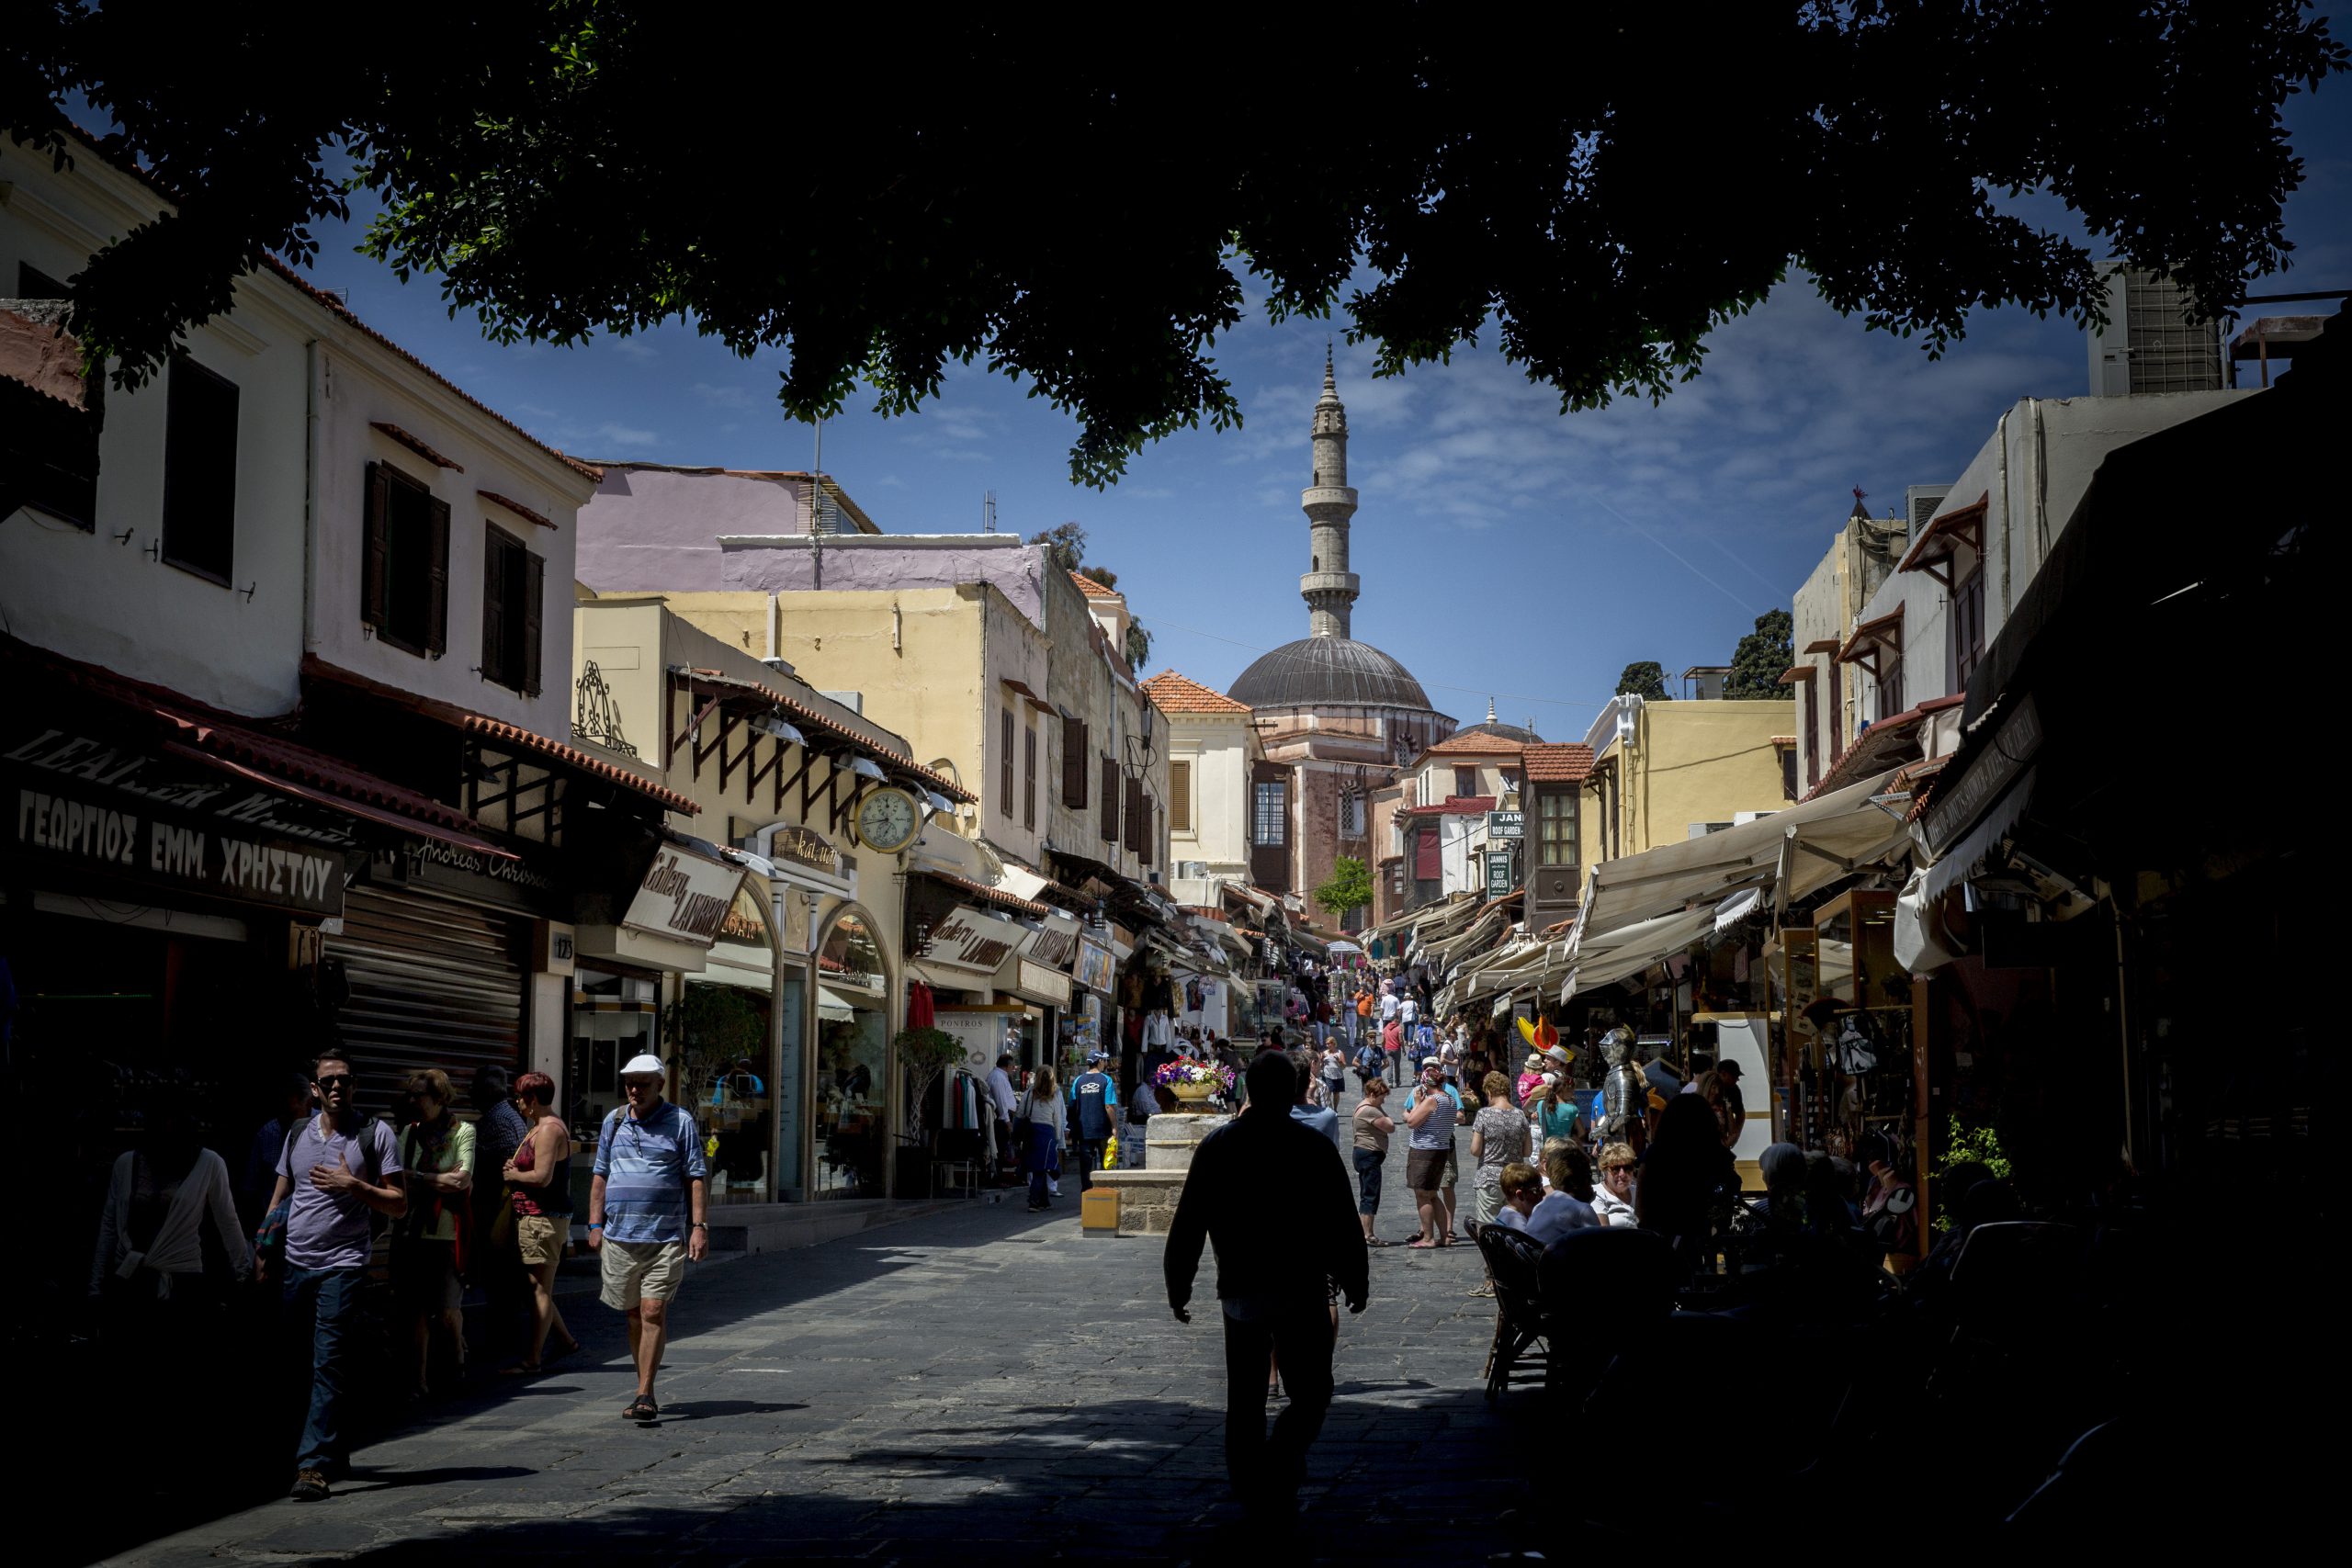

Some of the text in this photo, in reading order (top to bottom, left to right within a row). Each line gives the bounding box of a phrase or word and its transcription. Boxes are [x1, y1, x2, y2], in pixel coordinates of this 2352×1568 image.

[1492, 826, 1521, 835] ROOF GARDEN
[18, 788, 138, 864] ΓΕΩΡΓΙΟΣ
[220, 836, 333, 902] ΧΡΗΣΤΟΥ
[417, 837, 481, 875] Andreas
[1490, 855, 1508, 863] JANNIS
[643, 852, 691, 905] Gallery
[1493, 871, 1505, 879] ROOF
[1490, 880, 1508, 888] GARDEN
[558, 938, 572, 960] 123
